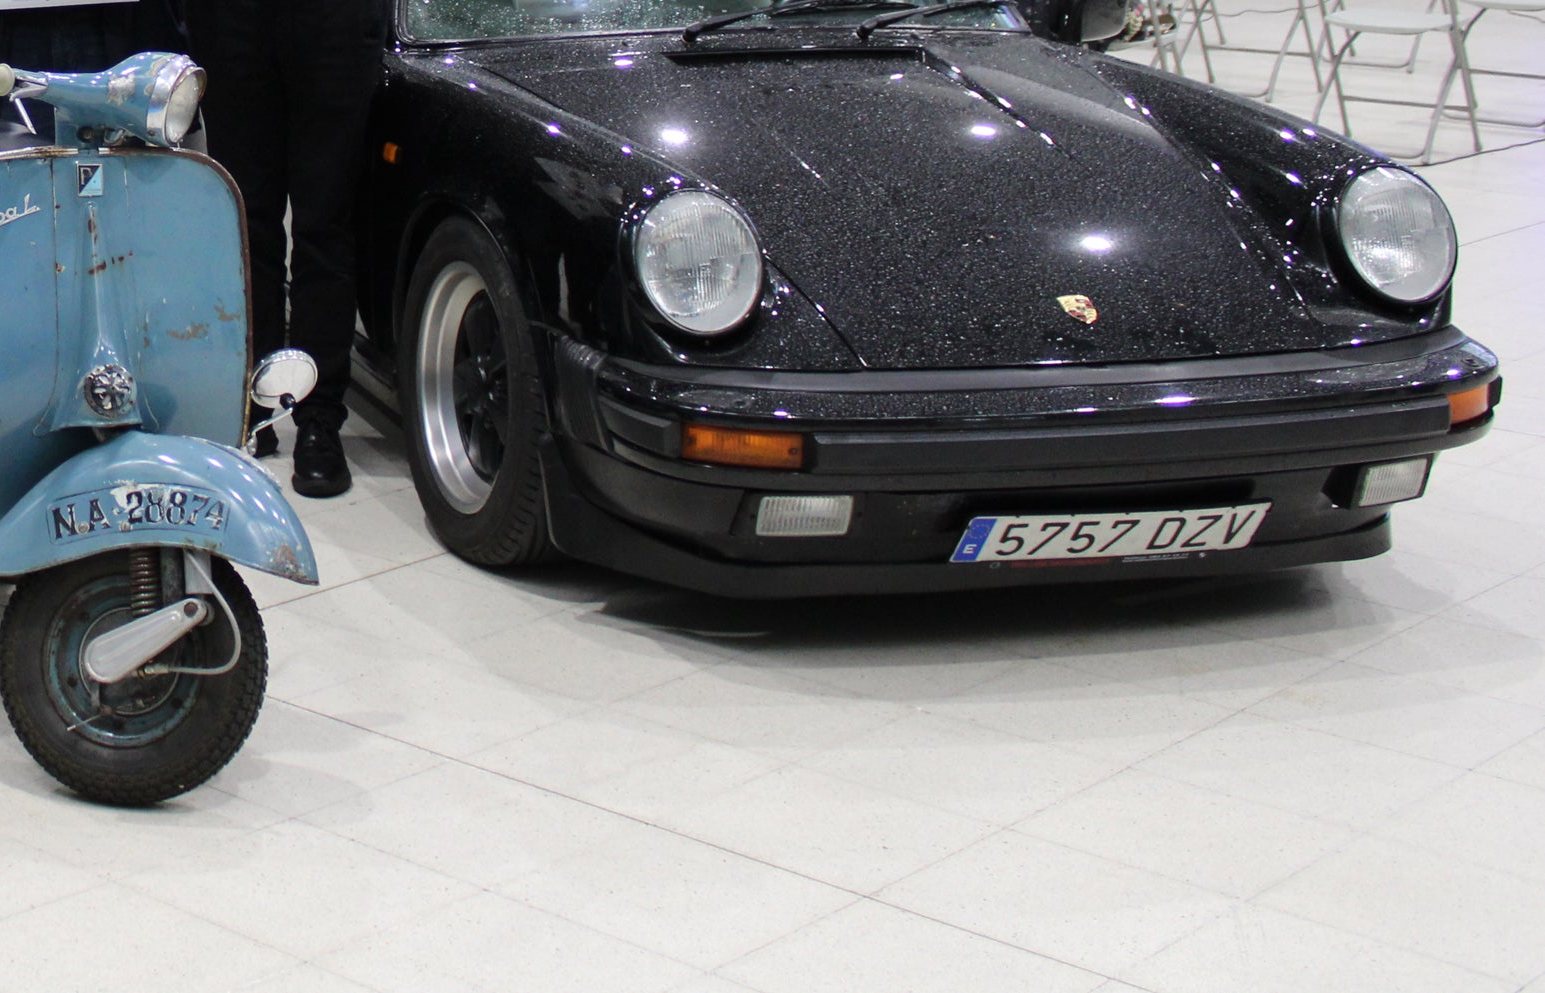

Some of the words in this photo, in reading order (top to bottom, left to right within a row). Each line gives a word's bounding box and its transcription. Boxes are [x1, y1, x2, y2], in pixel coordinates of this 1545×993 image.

[963, 544, 976, 554] E
[995, 518, 1141, 556] 5757
[1146, 509, 1255, 550] DZV
